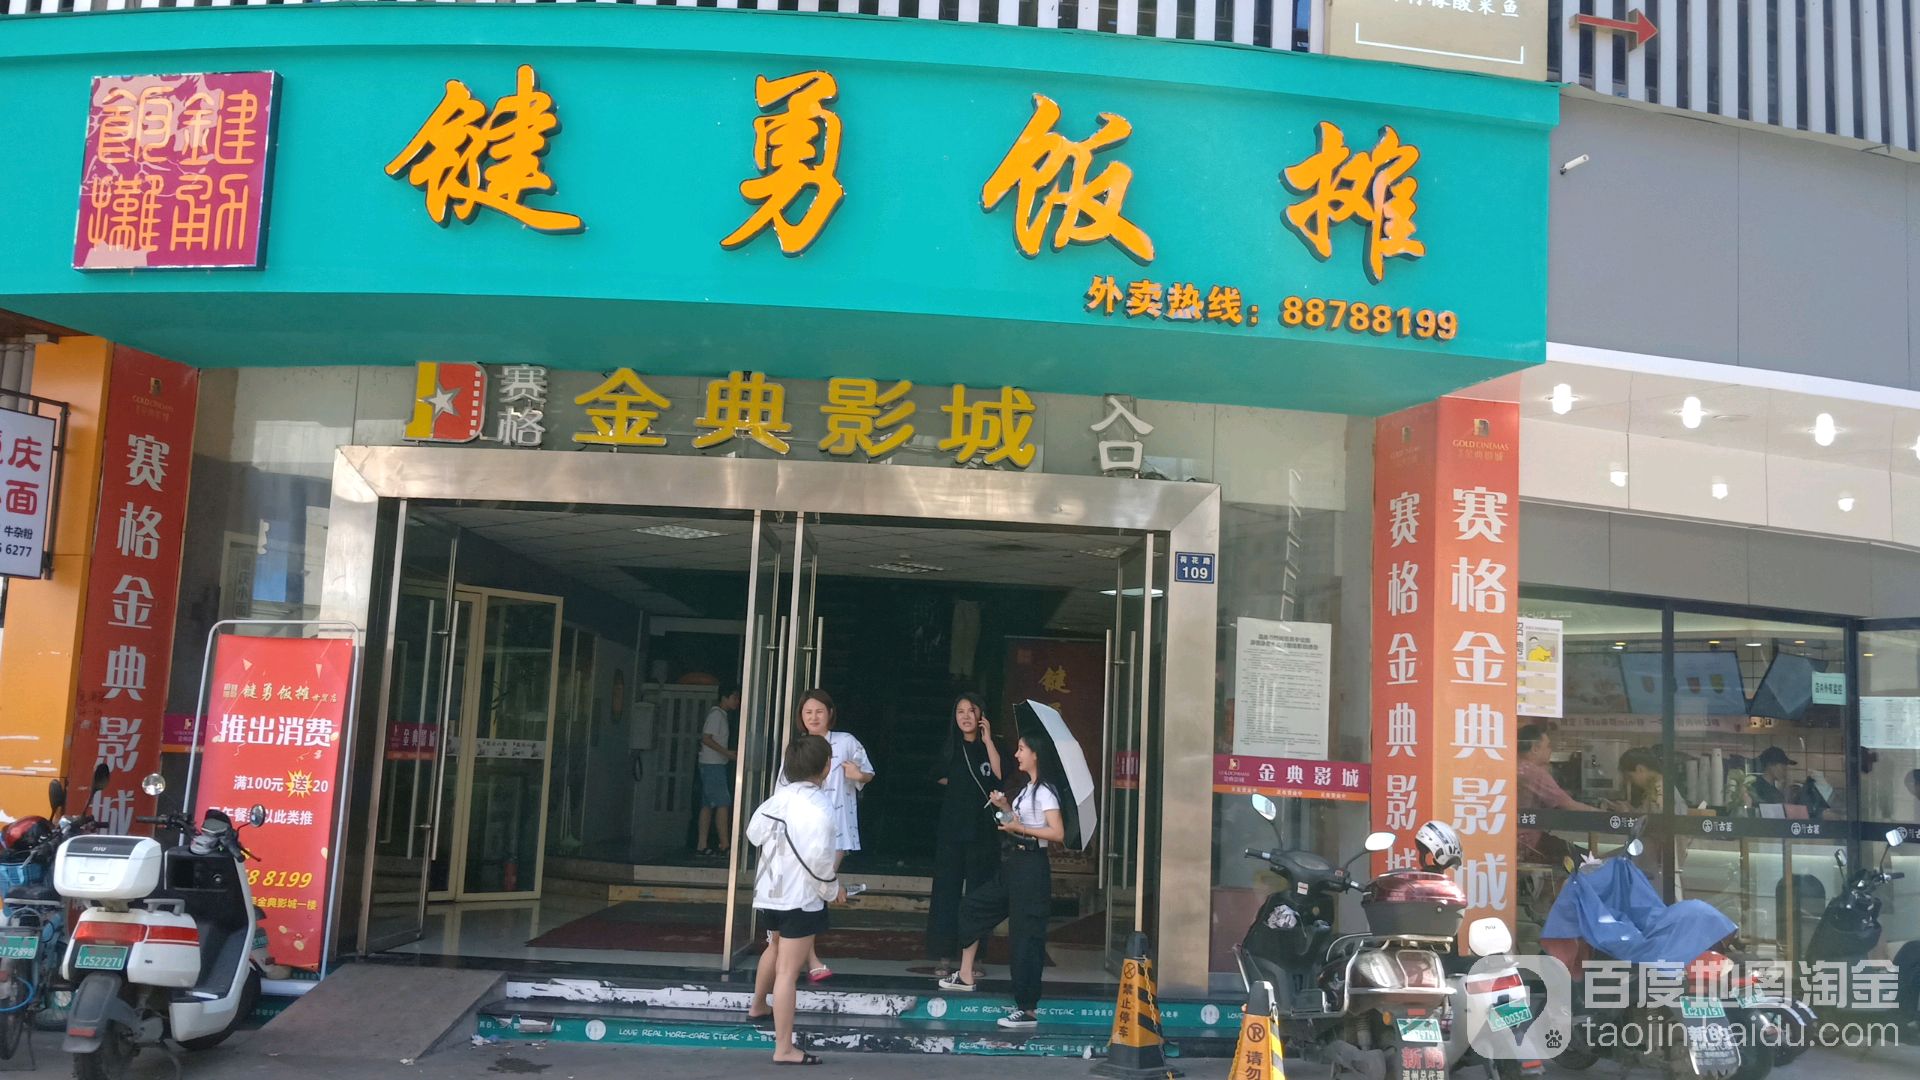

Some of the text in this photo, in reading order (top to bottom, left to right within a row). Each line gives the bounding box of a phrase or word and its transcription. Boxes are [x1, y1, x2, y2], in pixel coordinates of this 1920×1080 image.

[386, 65, 1427, 284] 键勇饭摊
[1281, 295, 1459, 340] 88788199
[501, 364, 548, 447] 赛格
[572, 367, 1037, 469] 金典影城
[5, 544, 32, 557] 6277
[1182, 566, 1208, 579] 109
[220, 713, 334, 747] 推出消费
[233, 775, 284, 792] 满100元
[312, 780, 329, 793] 20
[1257, 763, 1360, 788] 金典影城
[262, 870, 313, 889] 8199
[1117, 982, 1134, 1039] 禁止停车
